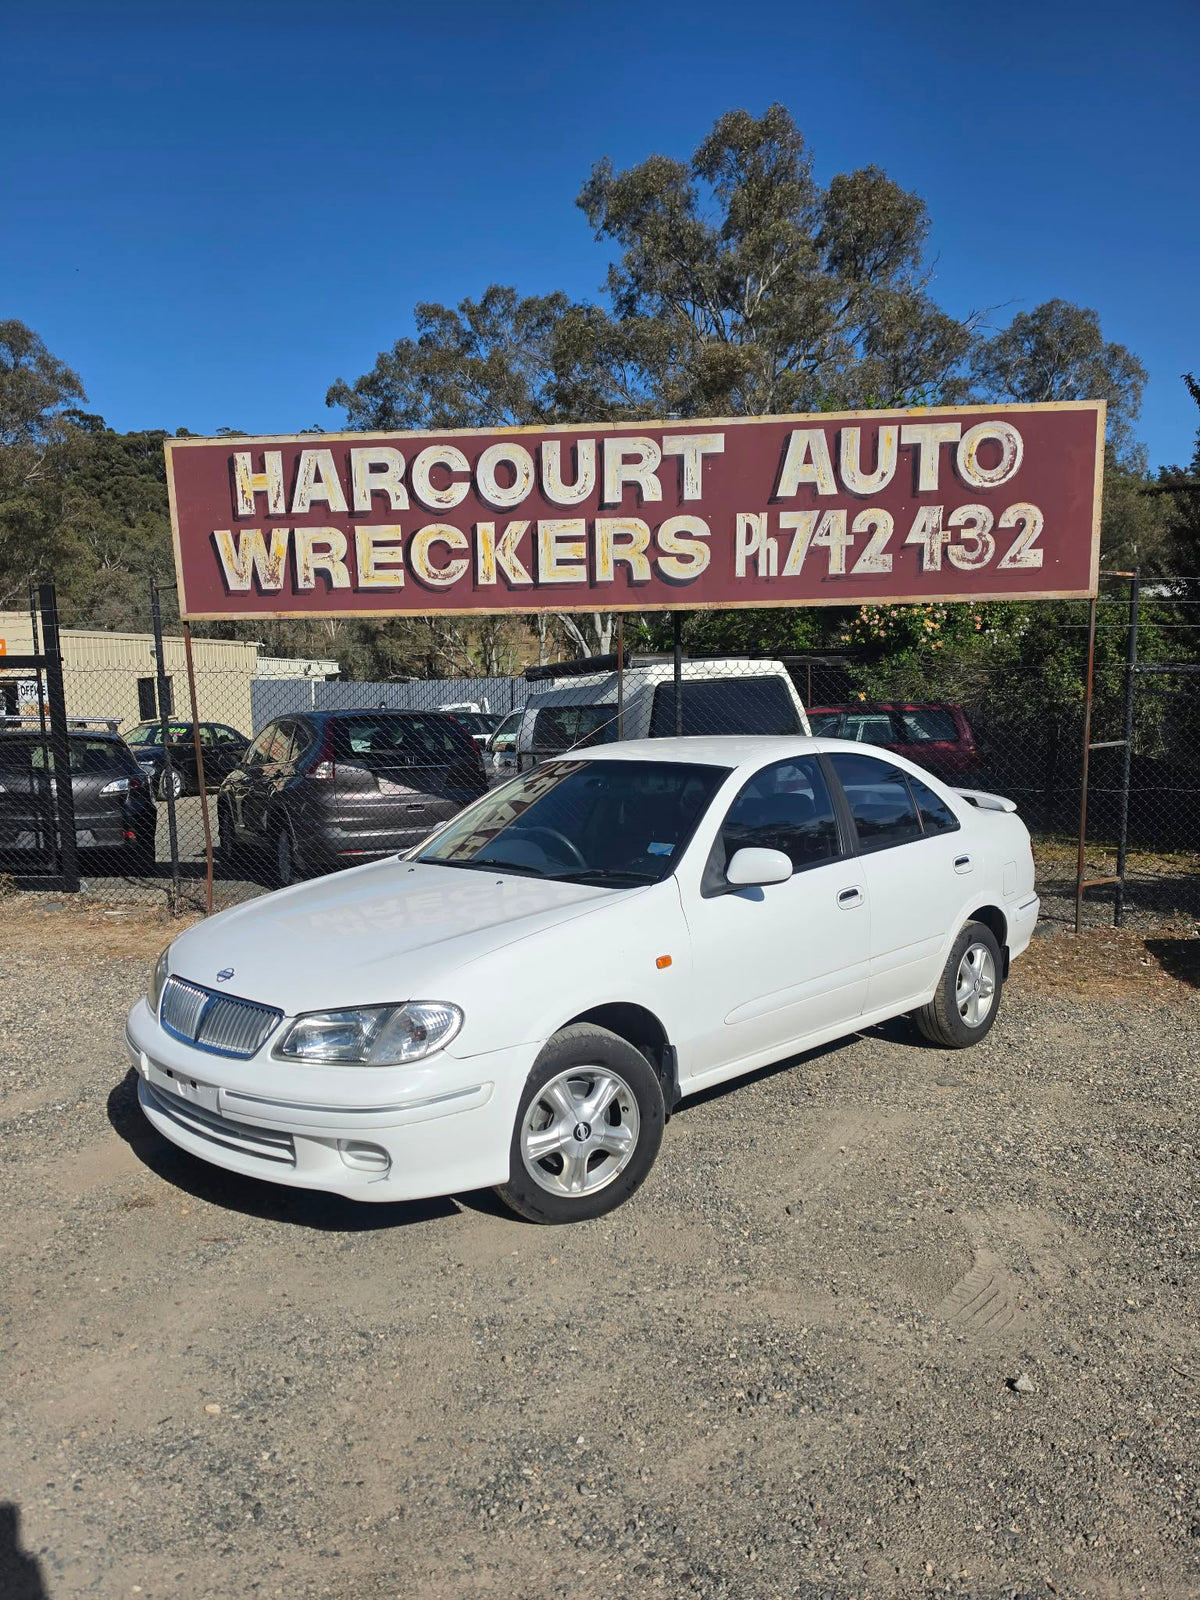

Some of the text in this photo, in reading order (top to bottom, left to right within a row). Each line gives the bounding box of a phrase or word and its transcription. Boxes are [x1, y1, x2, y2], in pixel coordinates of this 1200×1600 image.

[234, 421, 1024, 515] HARCOURT AUTO
[214, 515, 711, 590] WRECKERS
